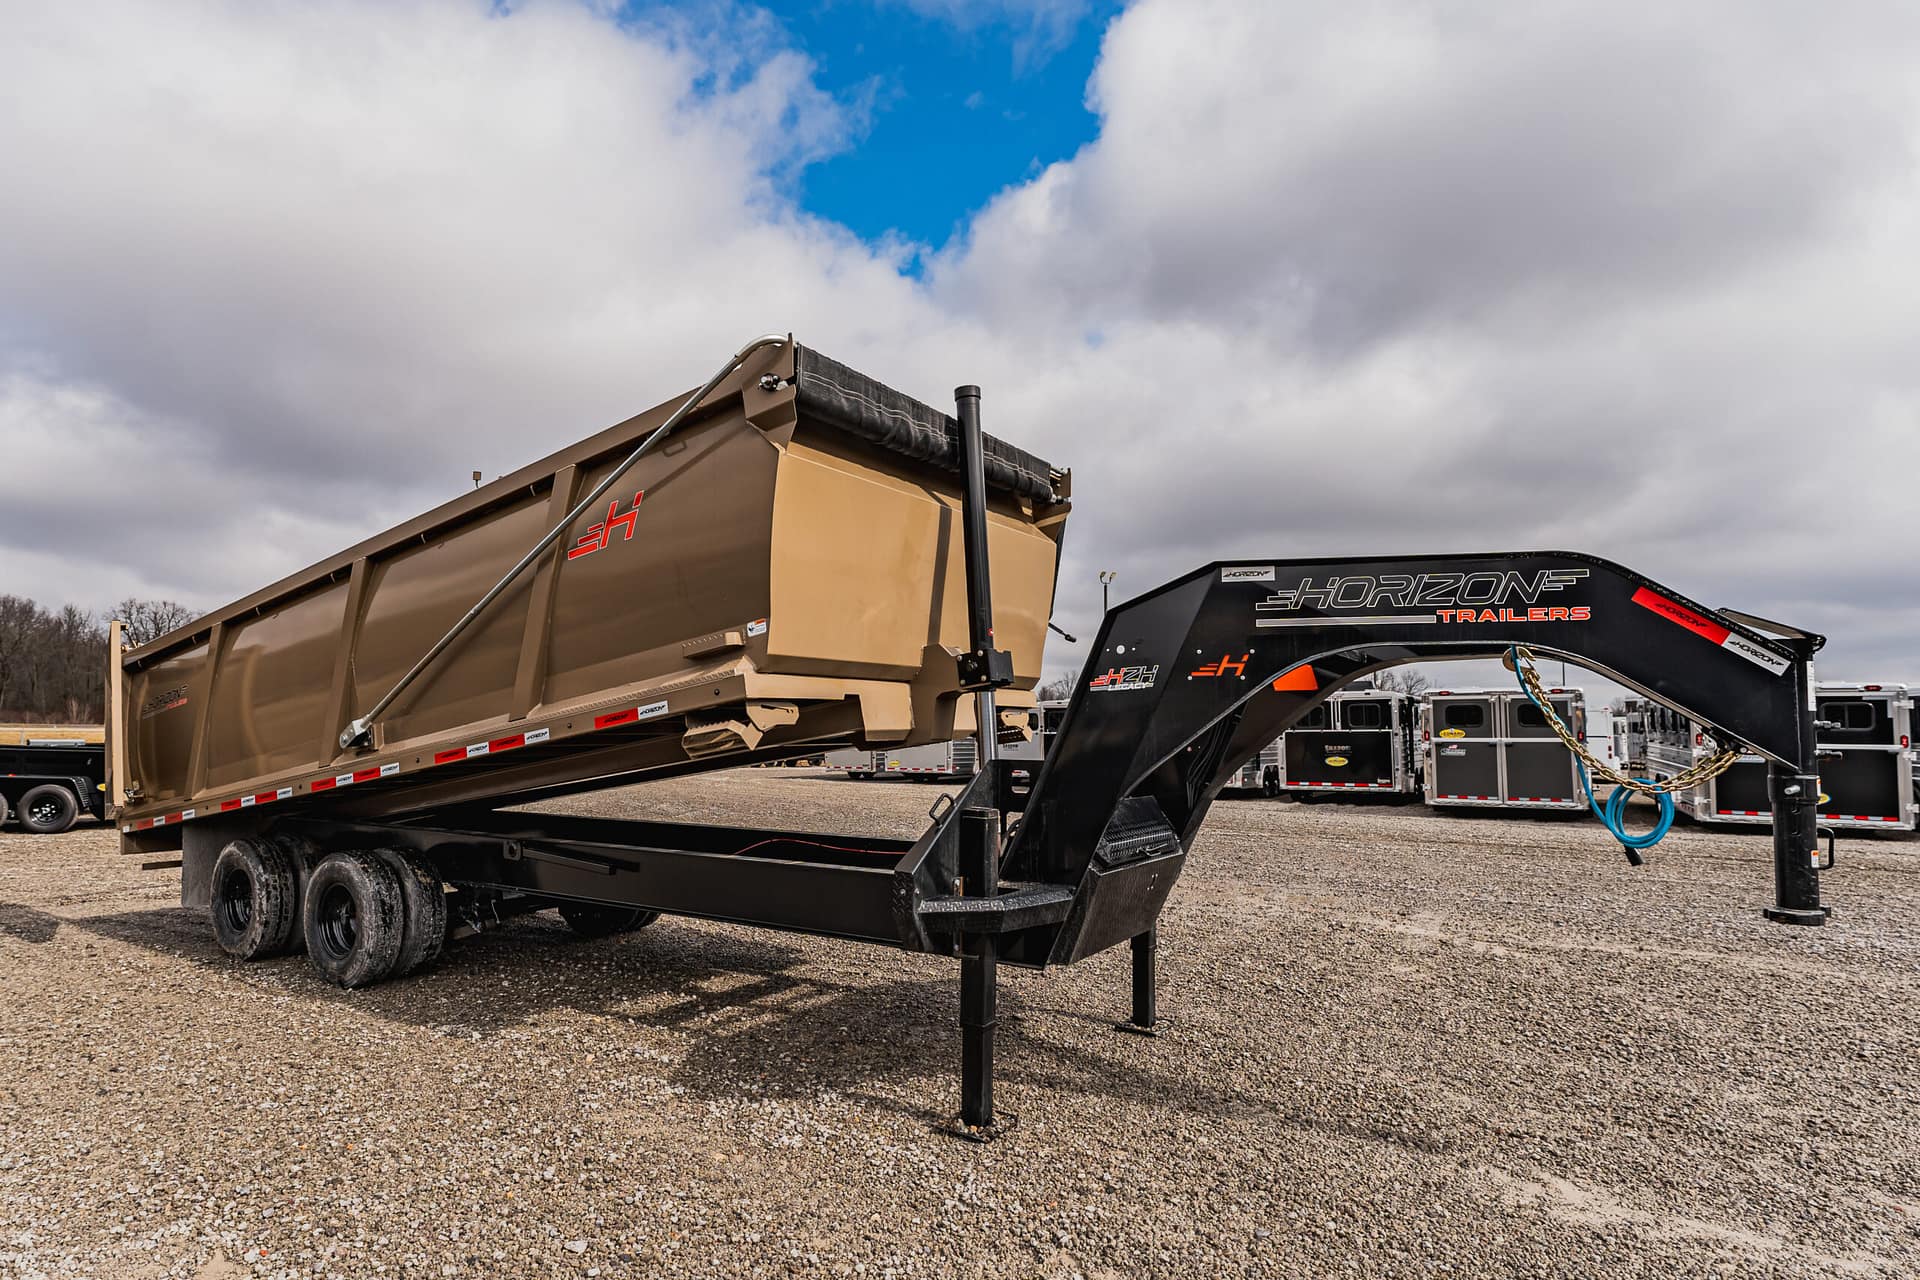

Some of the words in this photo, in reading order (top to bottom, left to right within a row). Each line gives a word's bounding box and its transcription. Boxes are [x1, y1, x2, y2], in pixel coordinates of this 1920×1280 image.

[1292, 570, 1548, 610] HORIZON
[1436, 606, 1591, 624] TRAILERS
[1660, 603, 1703, 628] HORIZON
[1733, 640, 1780, 667] HORIZON
